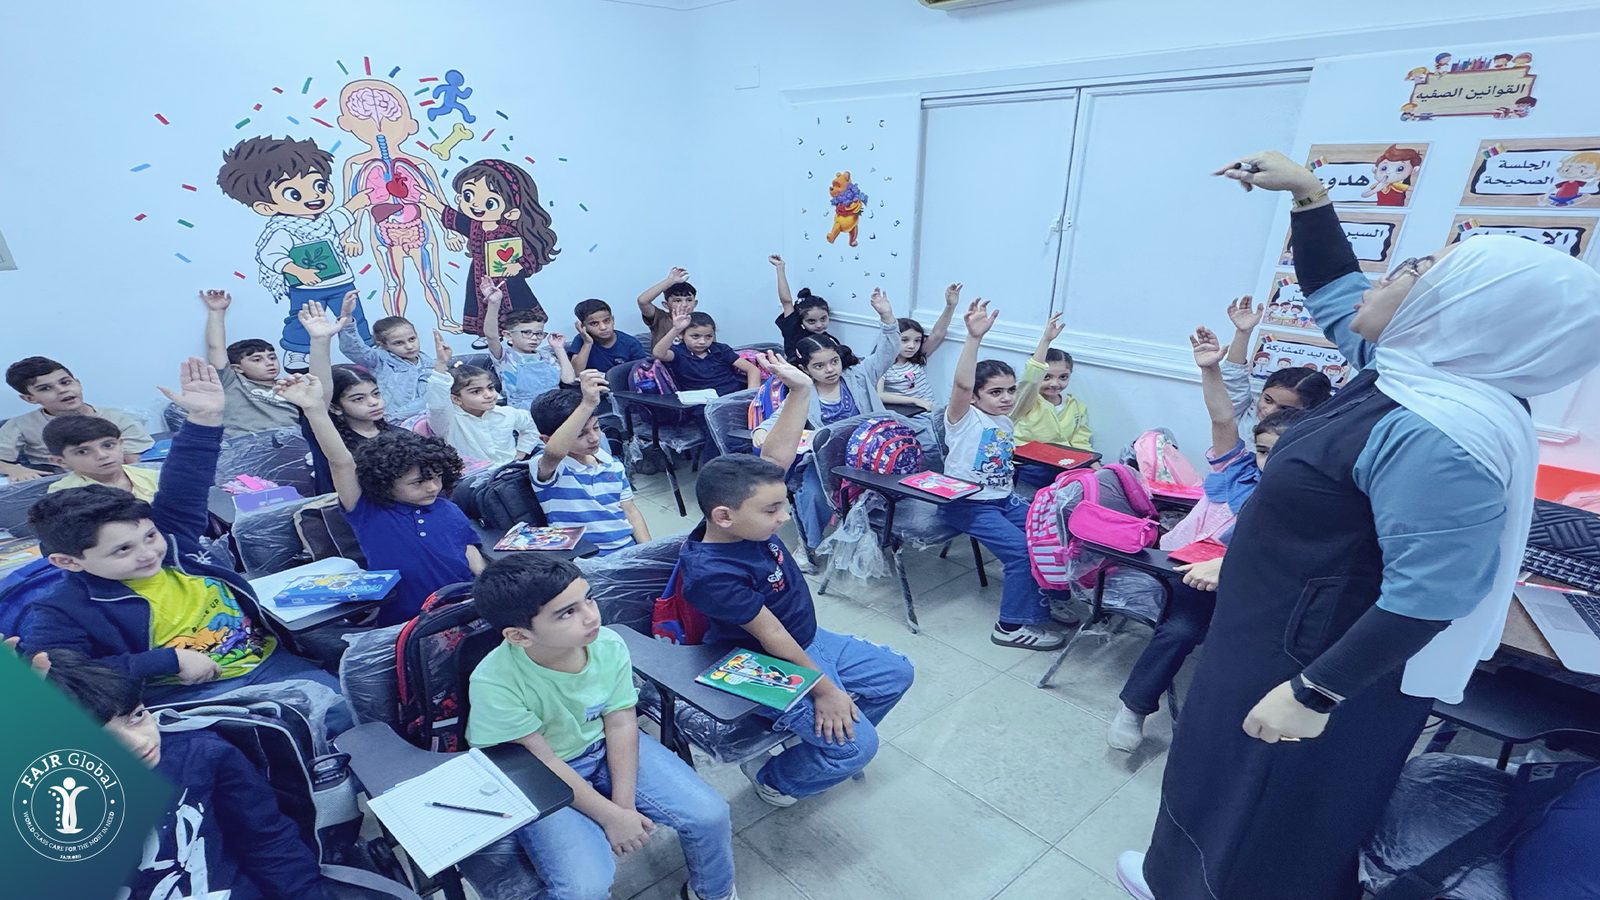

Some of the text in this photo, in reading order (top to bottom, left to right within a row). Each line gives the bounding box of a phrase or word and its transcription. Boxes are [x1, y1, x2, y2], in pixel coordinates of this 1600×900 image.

[1465, 83, 1526, 100] القوانين
[1498, 160, 1551, 172] الجلسة
[1483, 175, 1555, 188] الصحيحة
[1266, 343, 1305, 355] للمشاركة
[1325, 352, 1342, 363] رفع
